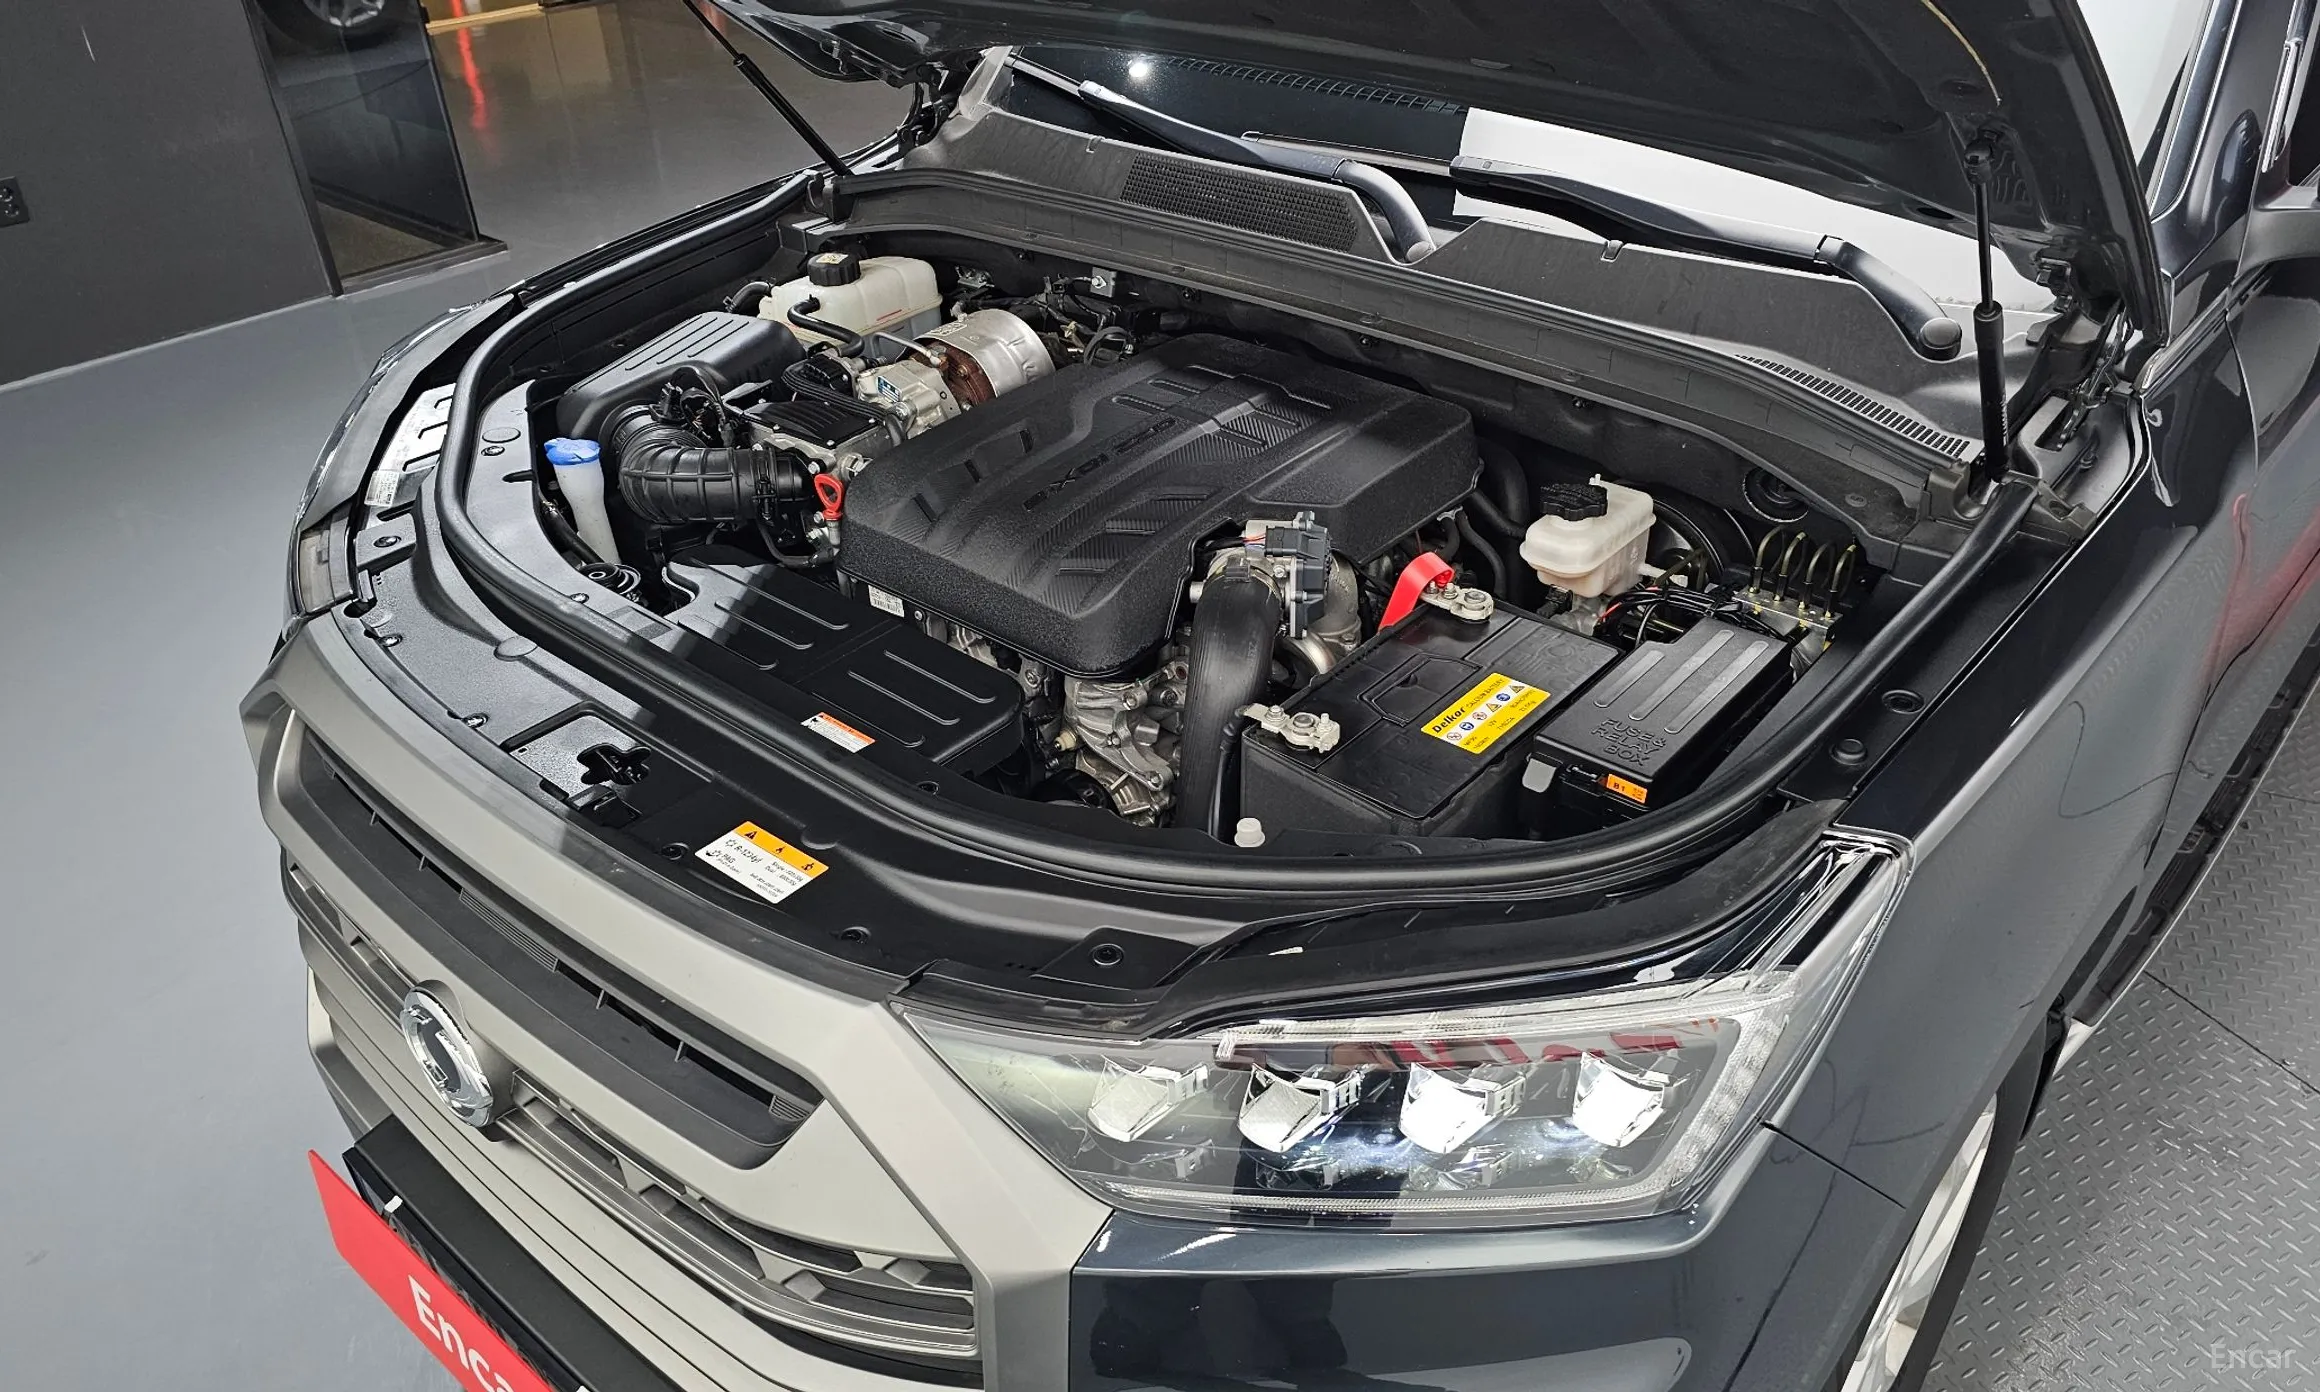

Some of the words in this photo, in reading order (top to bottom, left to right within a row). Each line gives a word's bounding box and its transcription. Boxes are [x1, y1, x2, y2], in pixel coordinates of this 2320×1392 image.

[1432, 707, 1466, 733] Delkor
[1591, 727, 1659, 754] RELAY
[1603, 745, 1650, 766] BOX
